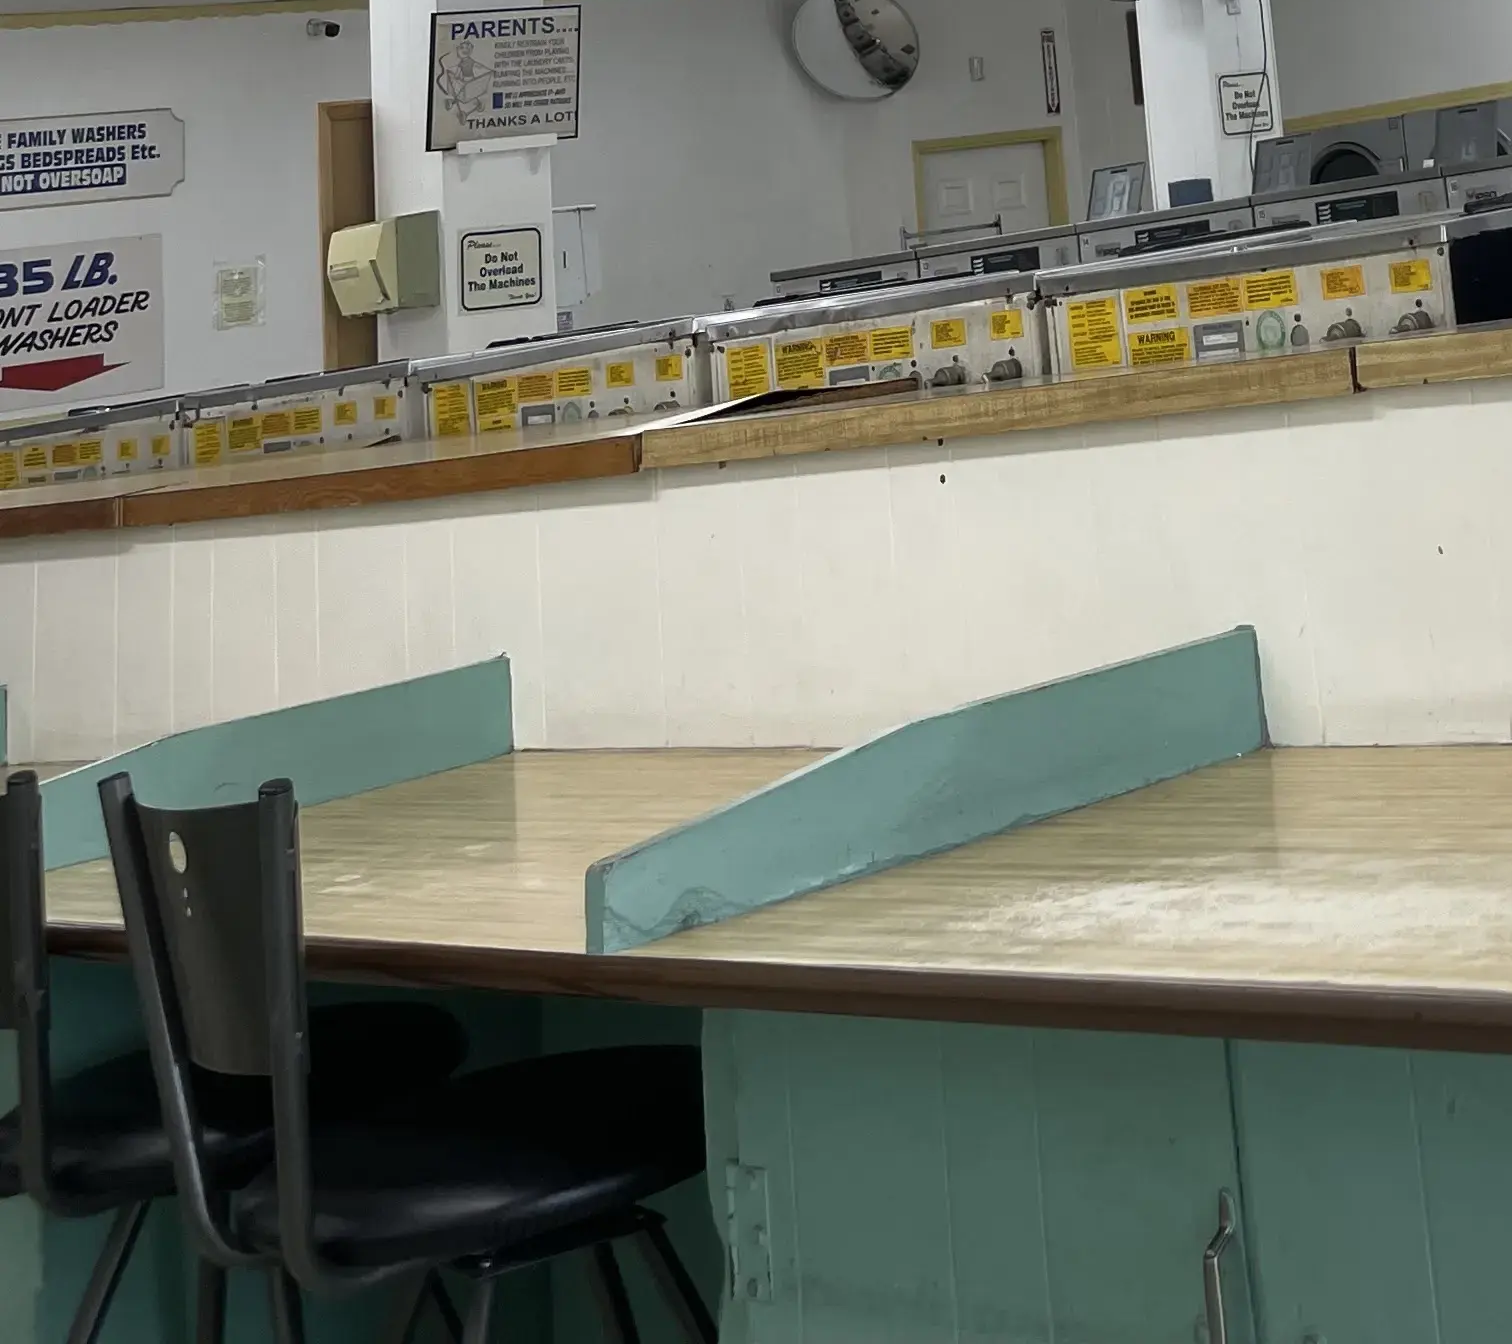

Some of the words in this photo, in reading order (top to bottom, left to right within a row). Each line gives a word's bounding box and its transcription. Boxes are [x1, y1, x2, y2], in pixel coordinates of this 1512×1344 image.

[467, 115, 526, 129] THANKS
[531, 114, 540, 124] A
[8, 129, 66, 149] FAMILY
[72, 123, 146, 144] WASHERS
[21, 145, 125, 169] BEDSPREADS
[131, 144, 160, 160] Etc.
[2, 174, 34, 192] NOT
[39, 166, 124, 189] OVERSOAP
[485, 253, 498, 263] Do
[501, 251, 518, 262] Not
[61, 252, 117, 291] LB.
[480, 264, 524, 277] Overload
[468, 281, 486, 292] The
[489, 277, 536, 290] Machines
[47, 291, 150, 323] LOADER
